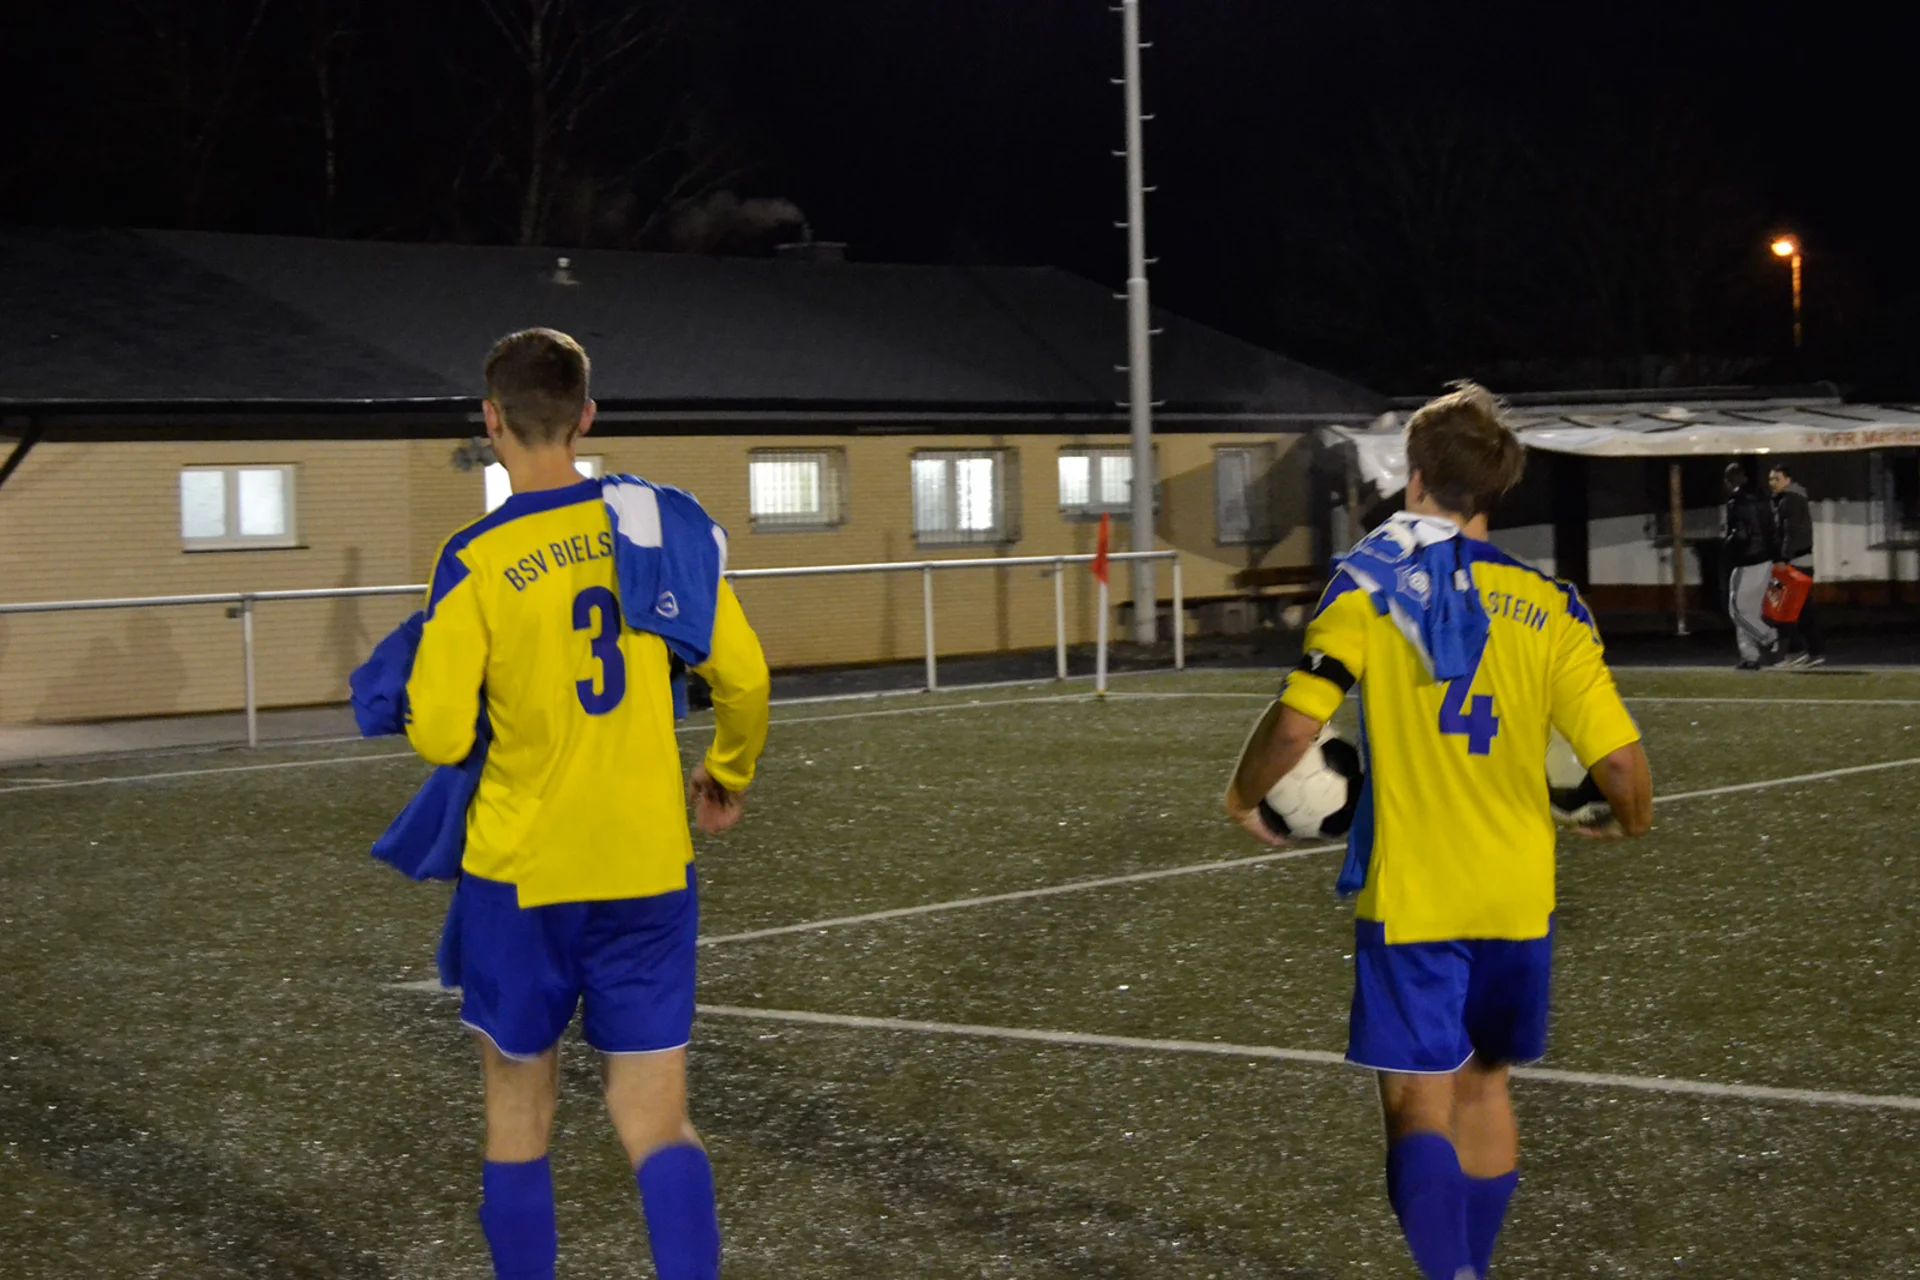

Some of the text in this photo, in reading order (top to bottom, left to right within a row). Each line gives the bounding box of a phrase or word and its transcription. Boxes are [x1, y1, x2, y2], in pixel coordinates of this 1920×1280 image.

[504, 531, 614, 592] BSV BIELS
[572, 585, 626, 717] 3
[1486, 591, 1549, 632] STEIN
[1438, 626, 1500, 756] 4
